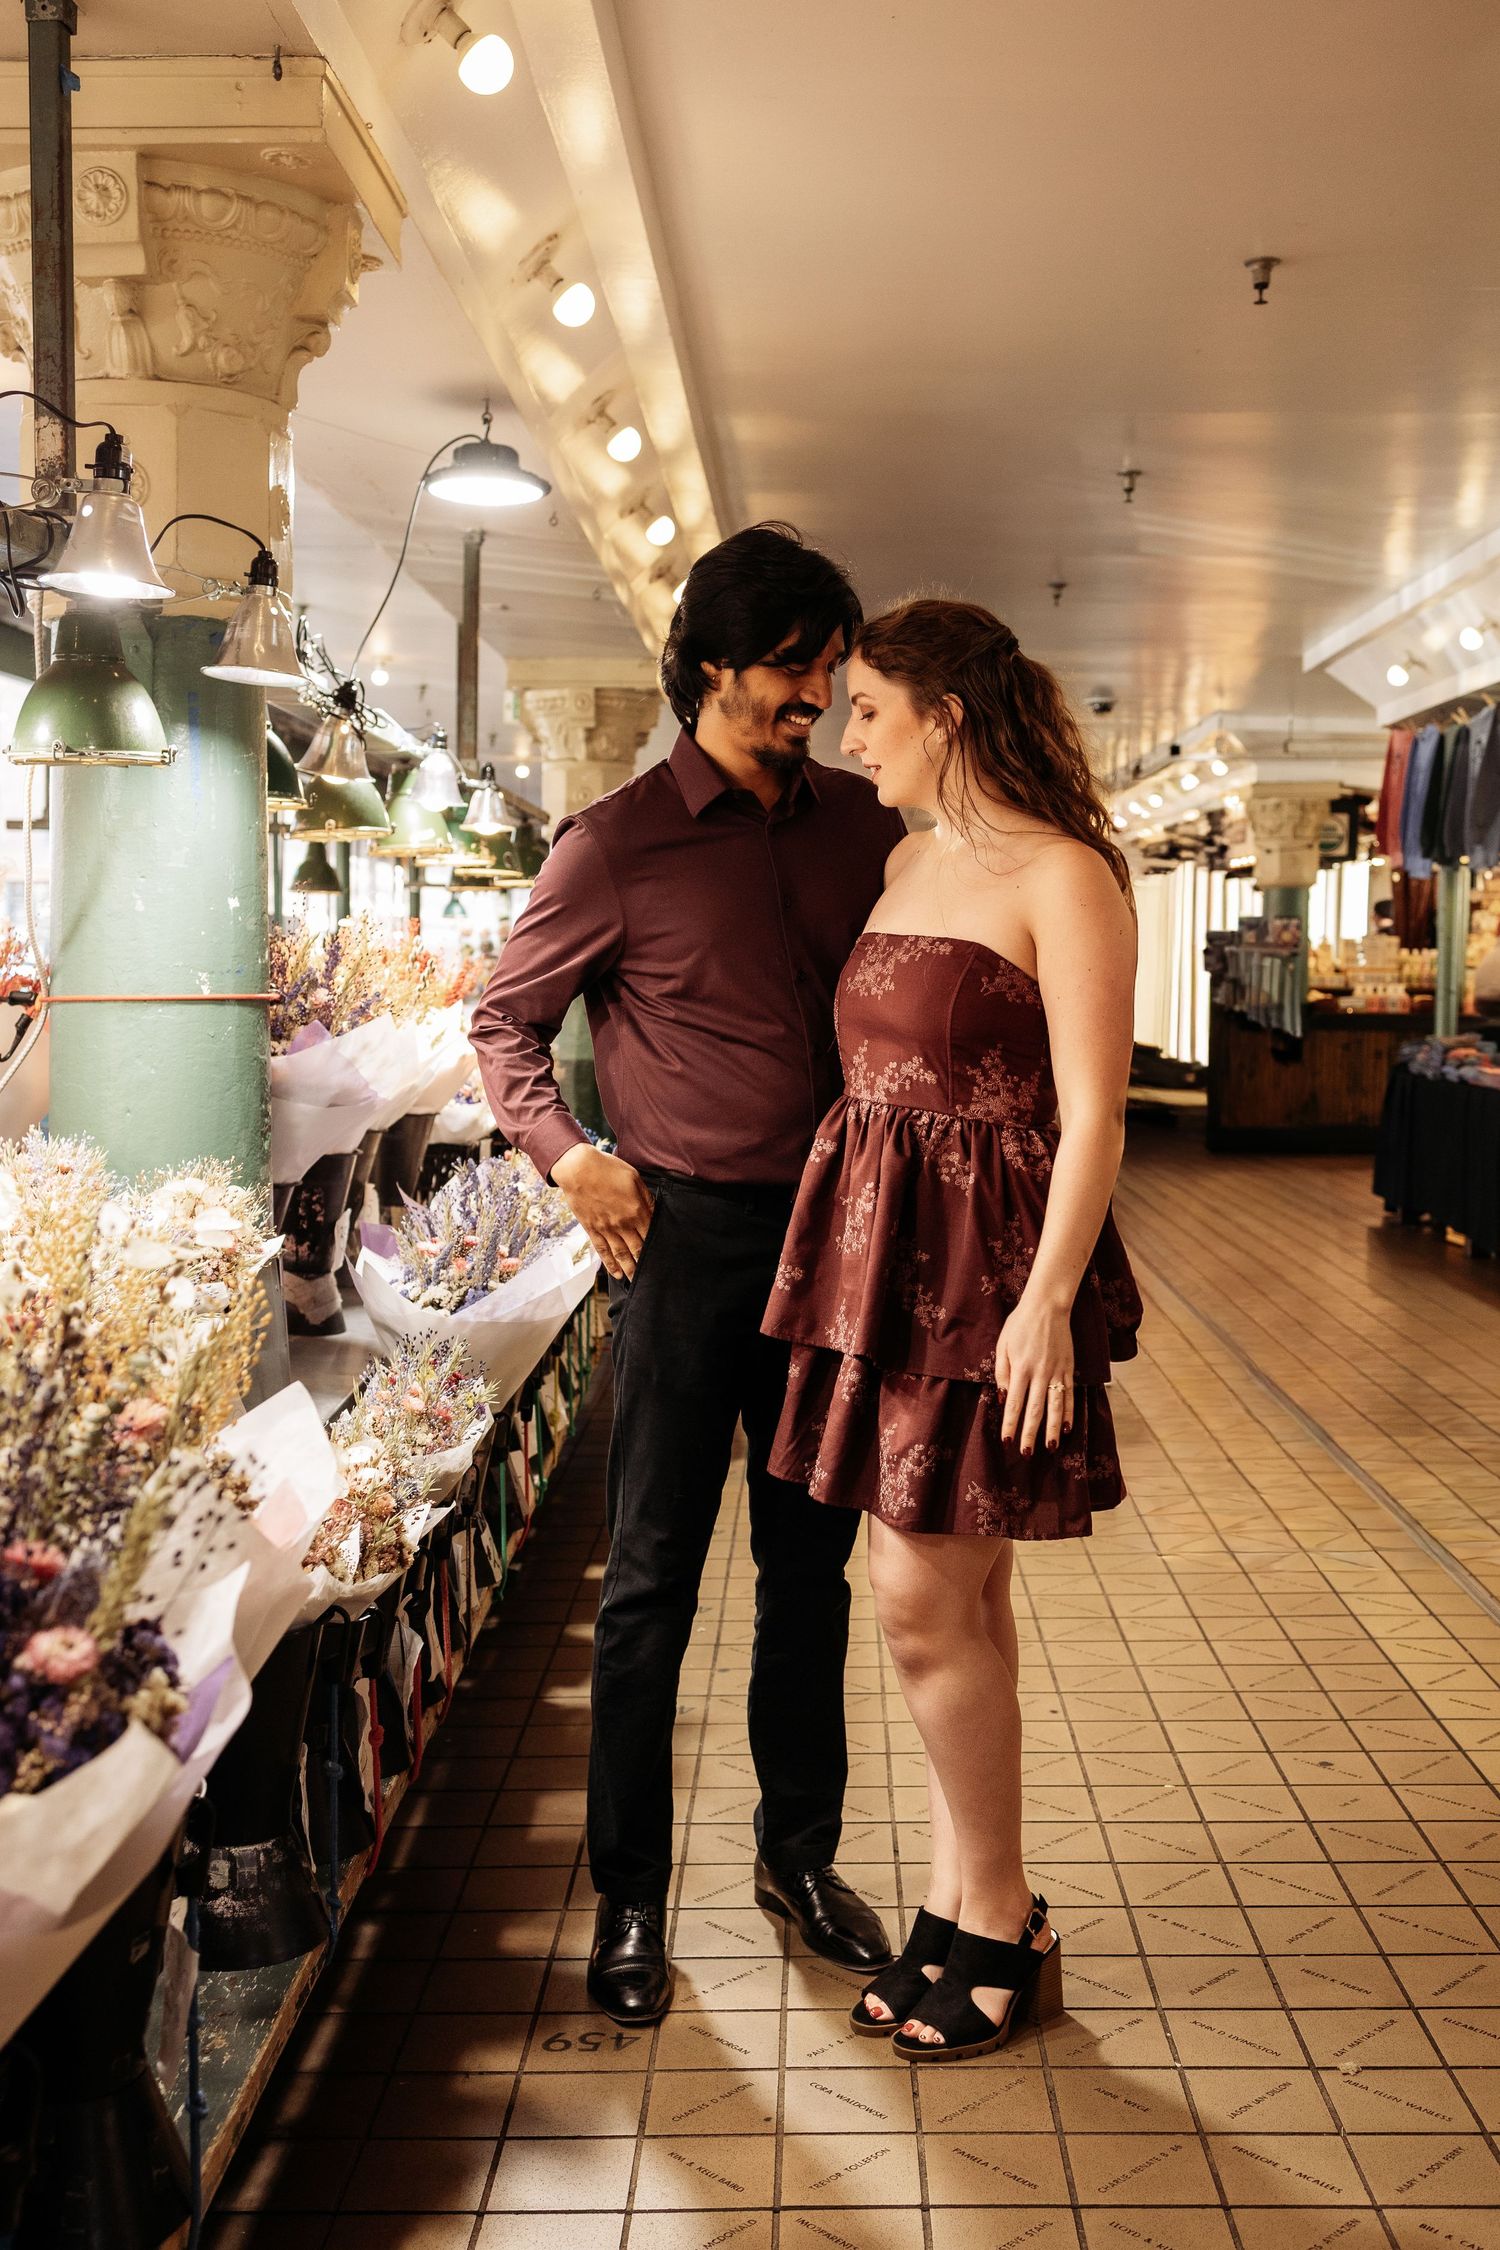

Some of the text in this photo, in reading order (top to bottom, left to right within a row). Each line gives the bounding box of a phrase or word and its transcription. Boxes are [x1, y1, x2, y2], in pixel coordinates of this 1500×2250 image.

[1027, 1869, 1057, 1882] WILLIAM
[1267, 1877, 1286, 1885] AND
[704, 1920, 757, 1945] REBECCA SWAN
[1070, 1918, 1105, 1935] MORRISON
[1170, 1921, 1188, 1930] MRS
[1209, 1935, 1242, 1949] HADLEY
[1285, 1932, 1307, 1945] JASON
[1311, 1916, 1336, 1930] BROWN
[1377, 1912, 1409, 1925] ROBERT
[1447, 1935, 1479, 1947] HARDY
[1075, 1975, 1111, 1991] LINCOLN
[1111, 1989, 1133, 2000] HALL
[1188, 1968, 1239, 1996] JEAN MURDOCK
[1300, 1968, 1329, 1980] HELEN
[1339, 1981, 1372, 1995] HUDEN
[541, 2032, 641, 2053] 459
[688, 2025, 751, 2055] LESLEY MORGAN
[806, 2047, 829, 2058] PAUL
[1189, 2020, 1216, 2032] JOHN
[1227, 2034, 1281, 2057] LIVINGSTON
[1332, 2047, 1349, 2058] RAY
[1347, 2031, 1376, 2049] MATYAS
[671, 2103, 710, 2122] CHARLES
[719, 2081, 755, 2100] NAVONI
[809, 2082, 888, 2120] CORA WALDOWSKI
[1093, 2087, 1151, 2113] ANNE WEGE
[1226, 2081, 1293, 2120] JASON IAN DILLON
[1342, 2079, 1453, 2122] JULIA ELLEN WANLESS
[667, 2151, 686, 2163] KIM
[695, 2166, 719, 2179] KELLI
[717, 2177, 745, 2193] BAIRD
[808, 2147, 891, 2190] TREVOR TOLLEFSON
[952, 2147, 1039, 2190] PAMELA R GADDIS
[1231, 2145, 1280, 2168] PENELOPE
[1295, 2172, 1343, 2194] MCALEES
[1394, 2177, 1419, 2194] MARY
[1425, 2160, 1446, 2174] DON
[1442, 2146, 1466, 2162] PERRY
[703, 2219, 757, 2249] MCDONALD
[998, 2220, 1054, 2250] STEVE STAHL
[1108, 2220, 1142, 2238] LLOYD
[1418, 2223, 1440, 2234] BILL
